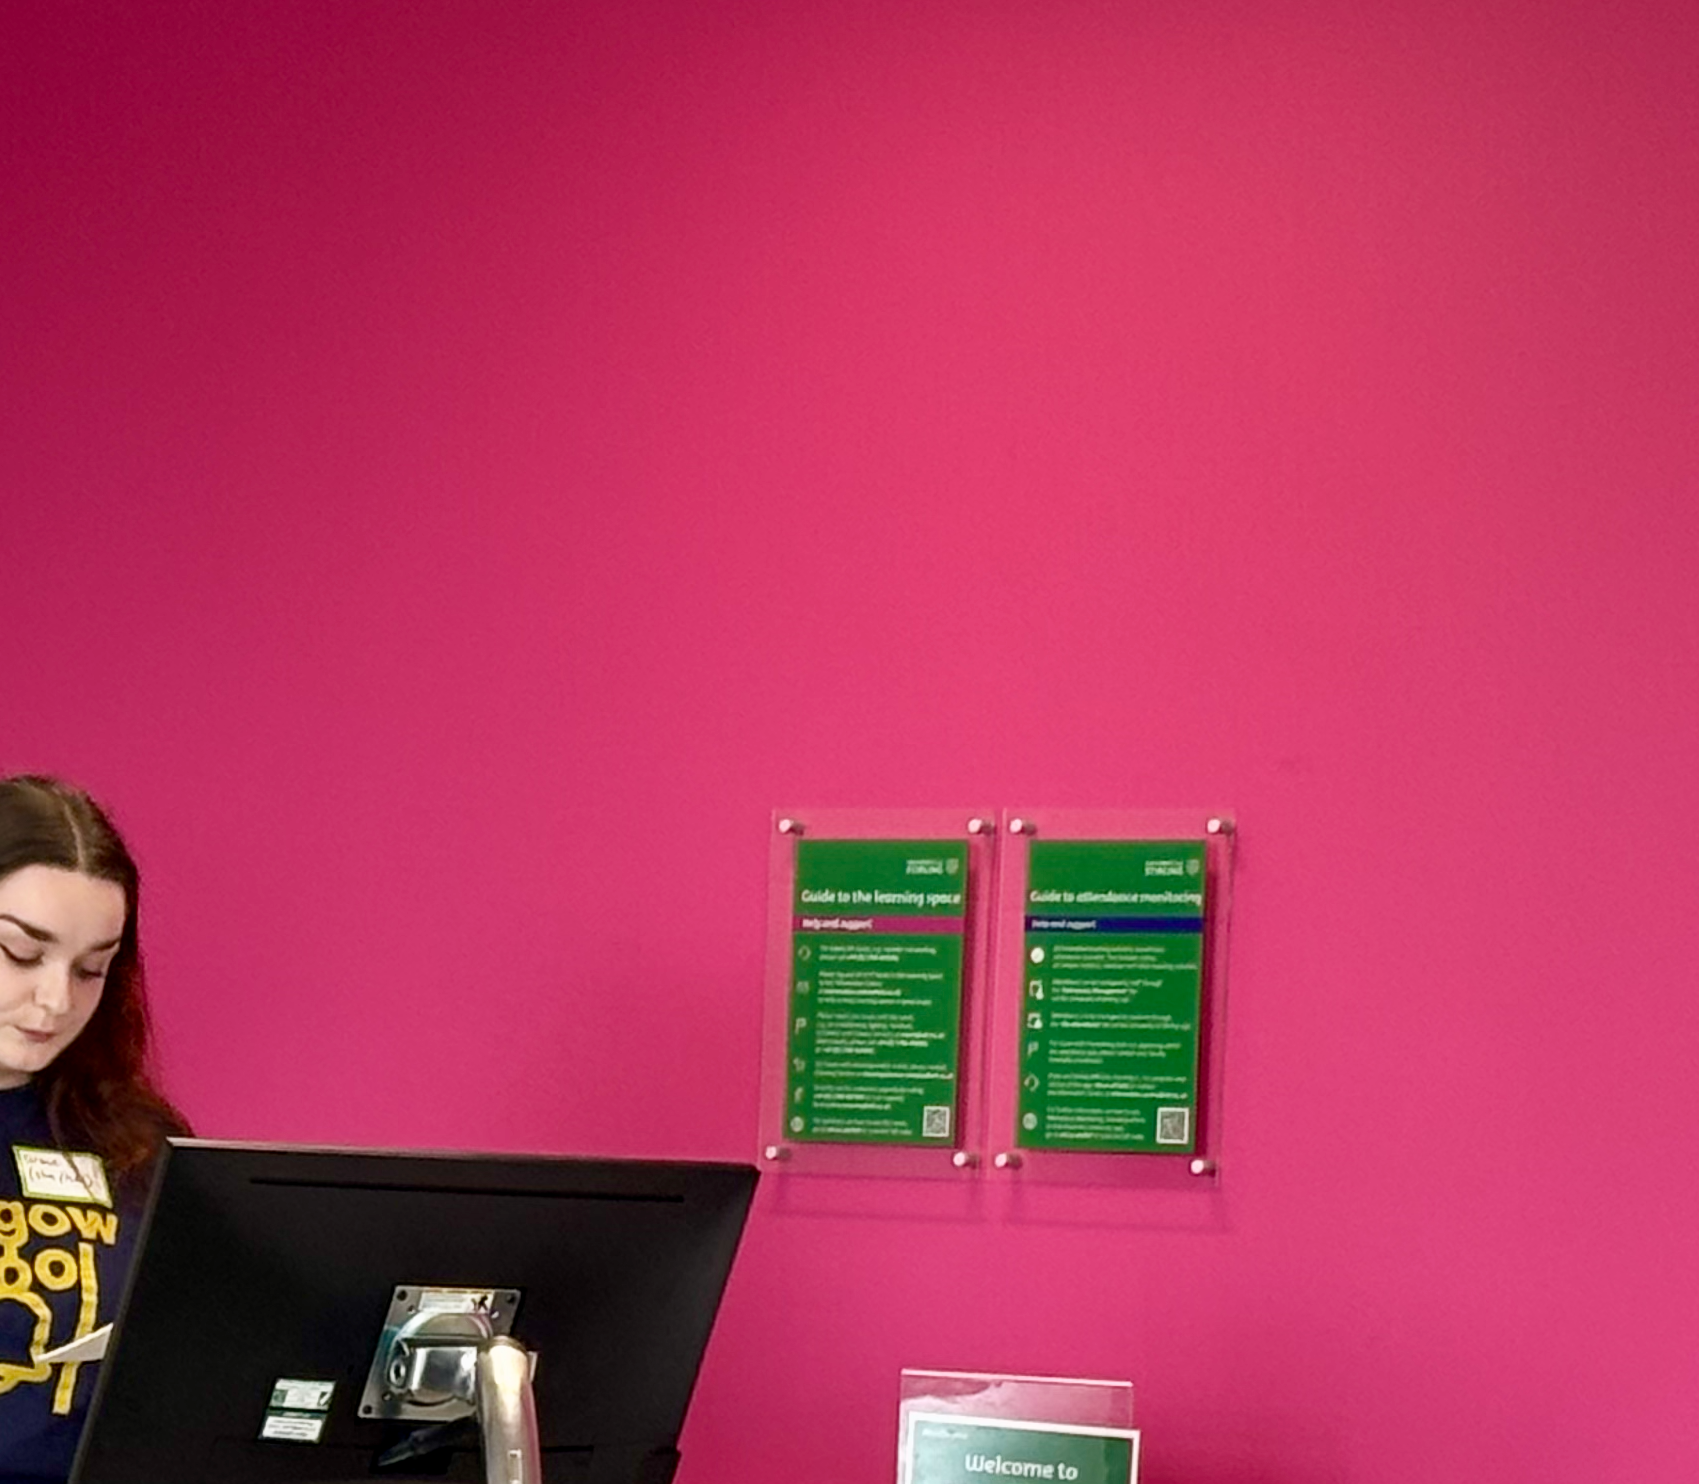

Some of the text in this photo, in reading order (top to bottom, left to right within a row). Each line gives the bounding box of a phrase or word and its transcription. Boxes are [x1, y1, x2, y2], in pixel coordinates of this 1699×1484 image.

[801, 889, 961, 908] Guide to the learning space
[1030, 890, 1202, 907] Guide to attendance monitoring
[964, 1453, 1079, 1481] Welcome to
